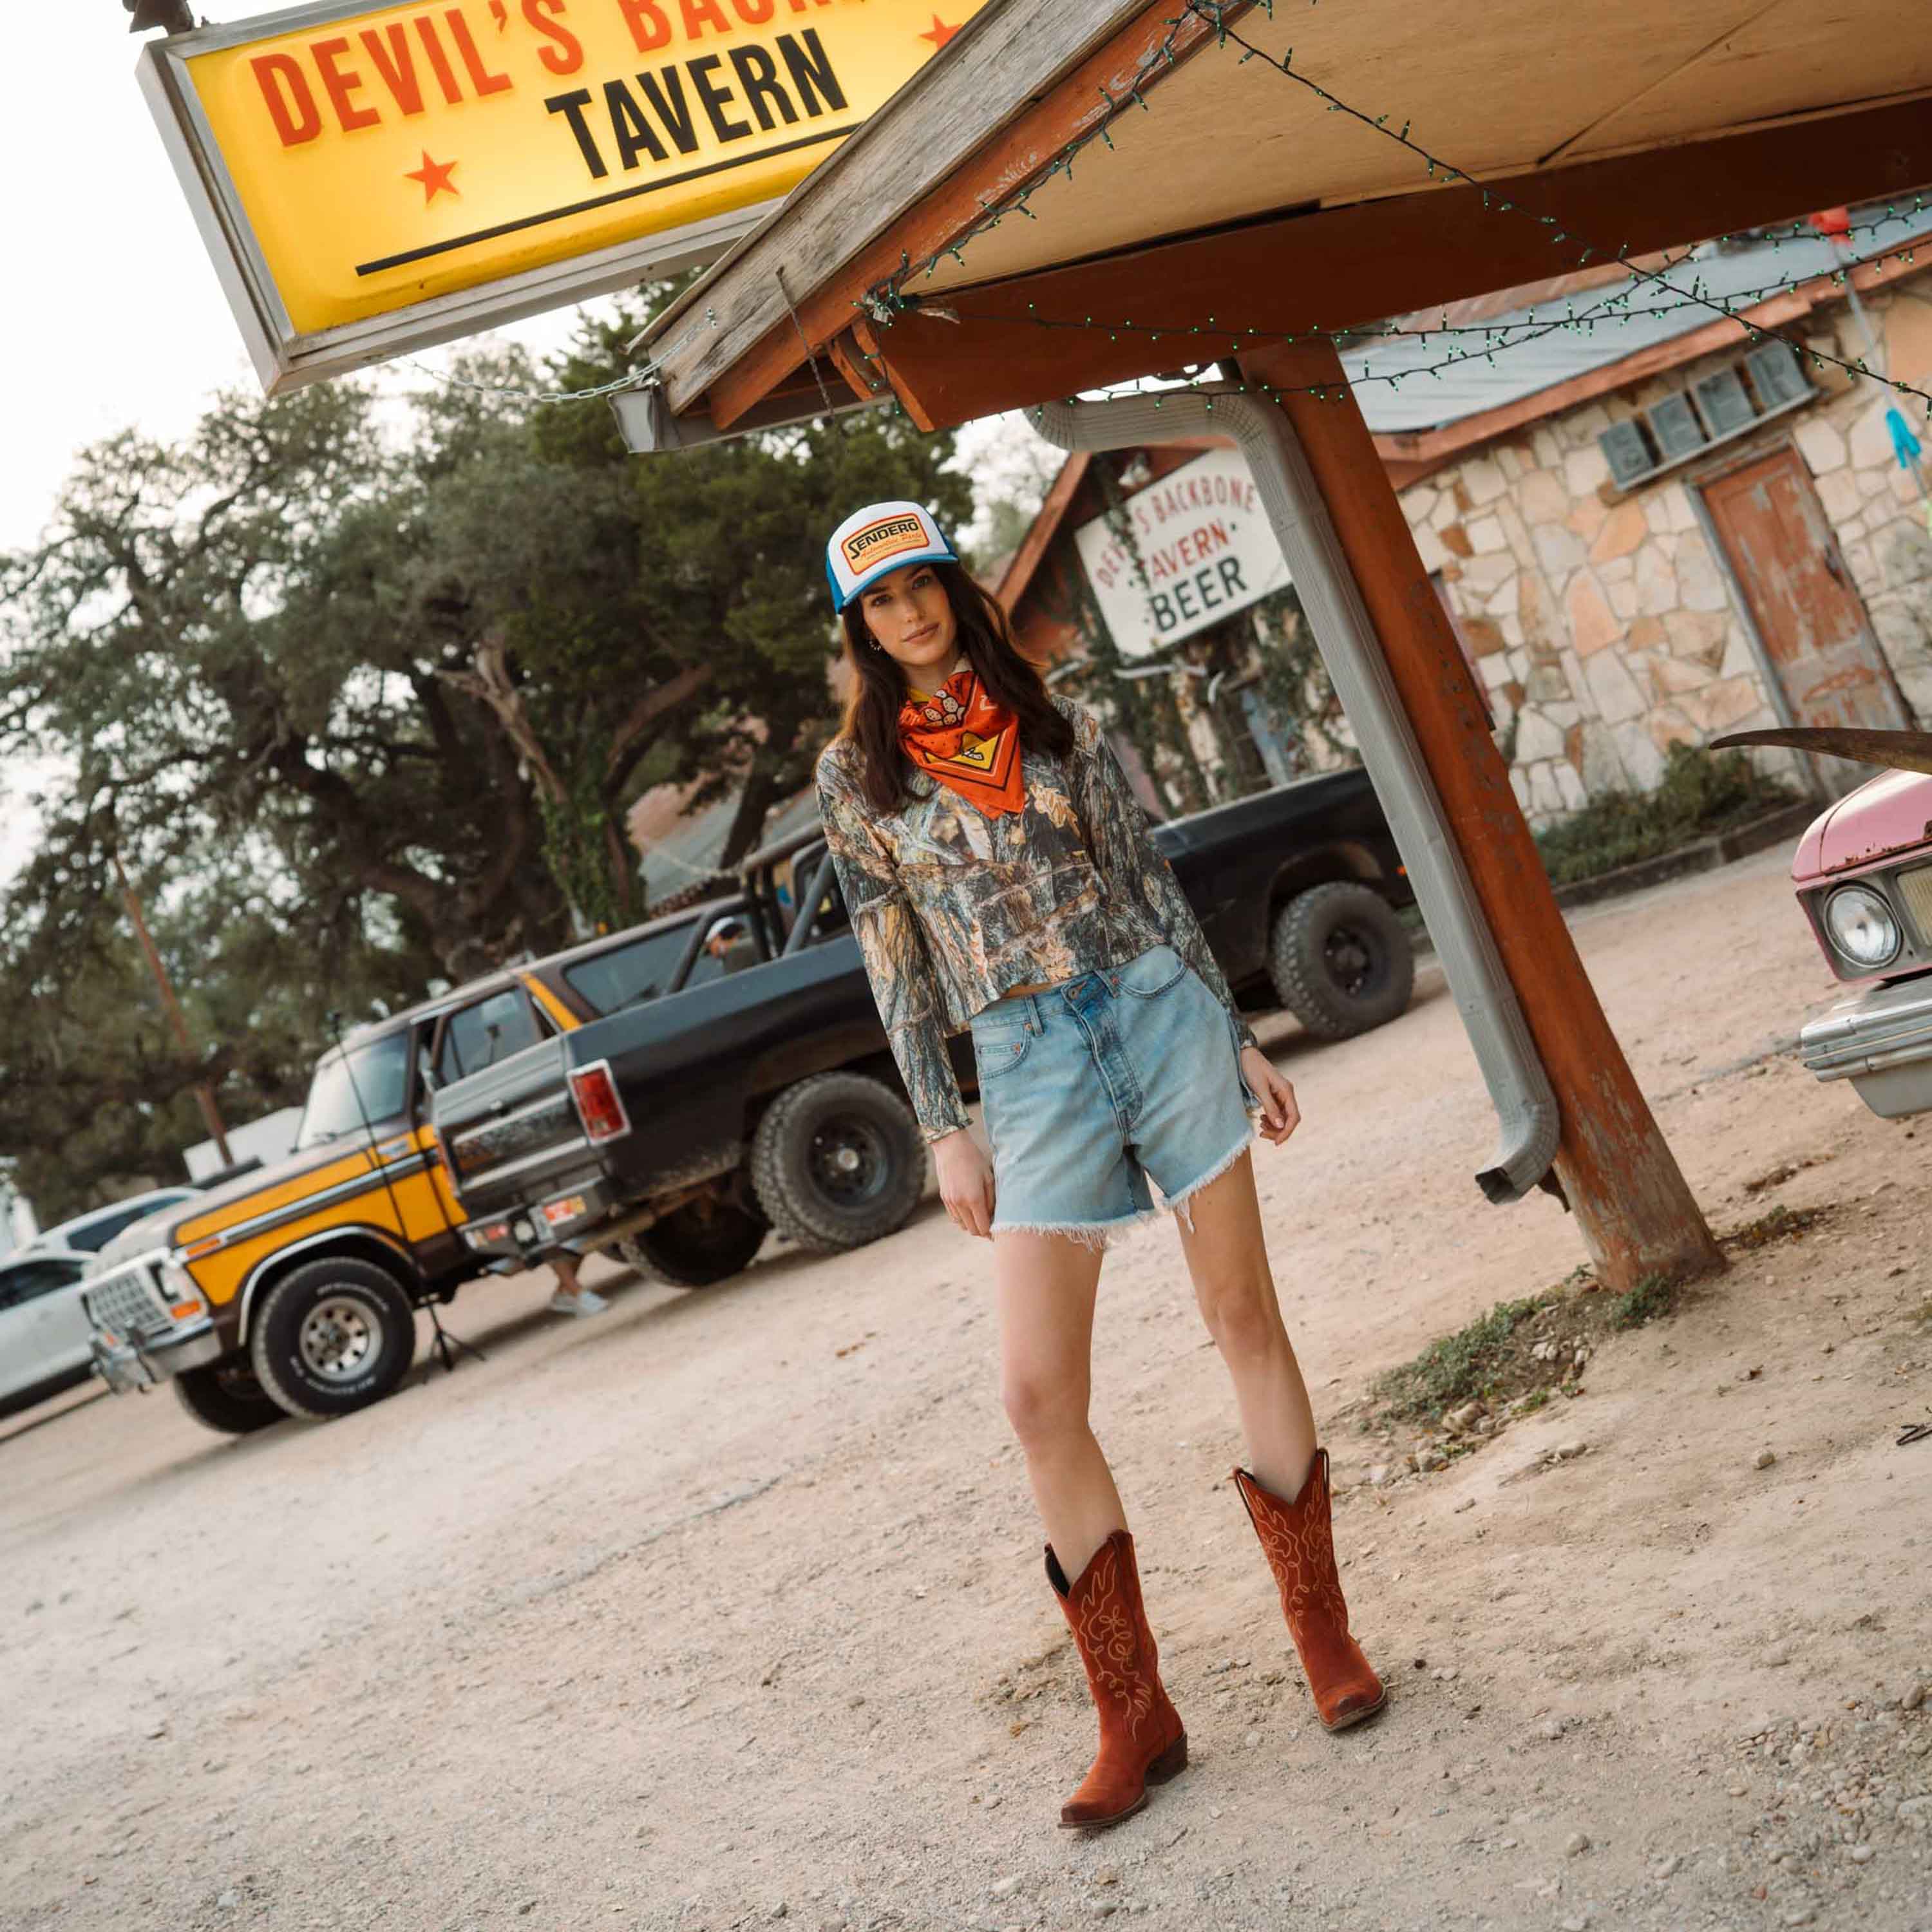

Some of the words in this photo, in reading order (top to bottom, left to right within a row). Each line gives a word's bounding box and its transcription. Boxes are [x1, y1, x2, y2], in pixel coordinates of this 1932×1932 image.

[250, 0, 584, 147] DEVIL'S
[544, 28, 848, 180] TAVERN
[1151, 475, 1255, 524] BACKBONE
[848, 518, 919, 560] SENDERO
[1140, 516, 1229, 583] AVERN
[1147, 556, 1247, 632] BEER
